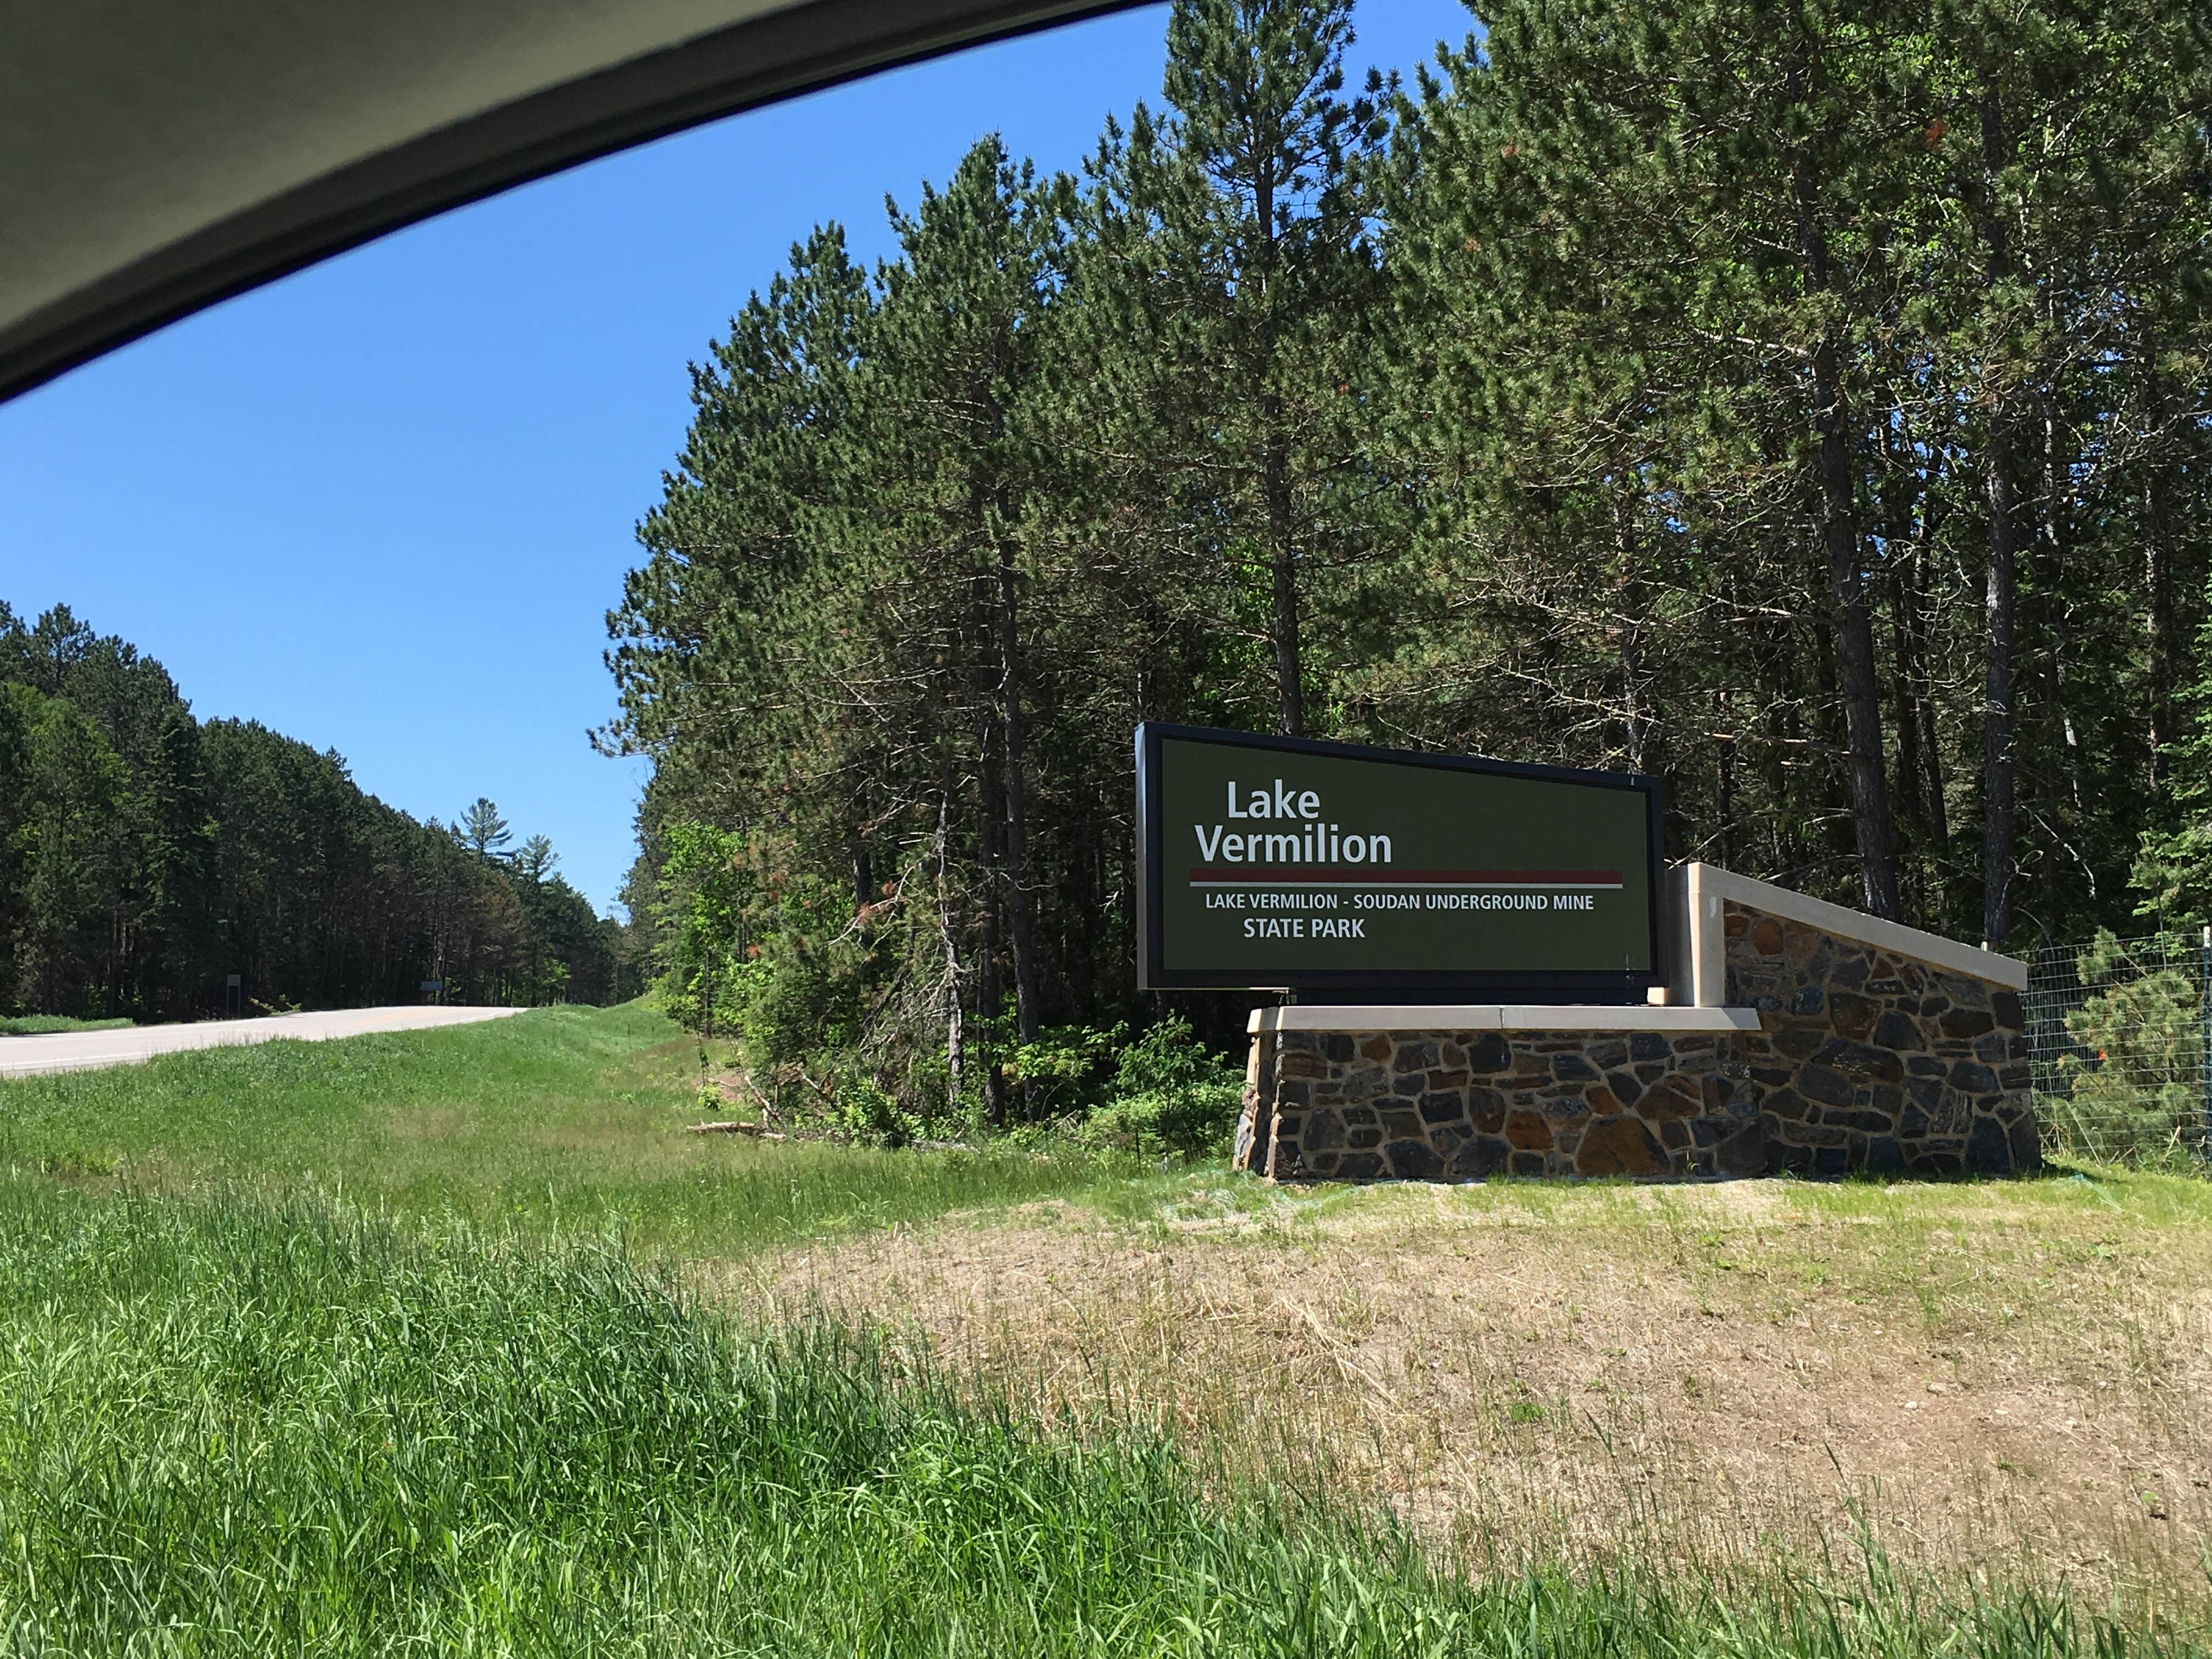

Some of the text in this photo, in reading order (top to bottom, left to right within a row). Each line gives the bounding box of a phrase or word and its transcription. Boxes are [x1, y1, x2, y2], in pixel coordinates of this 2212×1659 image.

[1228, 779, 1320, 819] Lake
[1194, 823, 1392, 863] Vermilion
[1206, 894, 1245, 909] LAKE
[1249, 894, 1338, 909] VERMILION
[1353, 894, 1421, 910] SOUDAN
[1425, 894, 1548, 910] UNDERGROUND
[1553, 895, 1594, 910] MINE
[1244, 918, 1365, 938] STATE PARK
